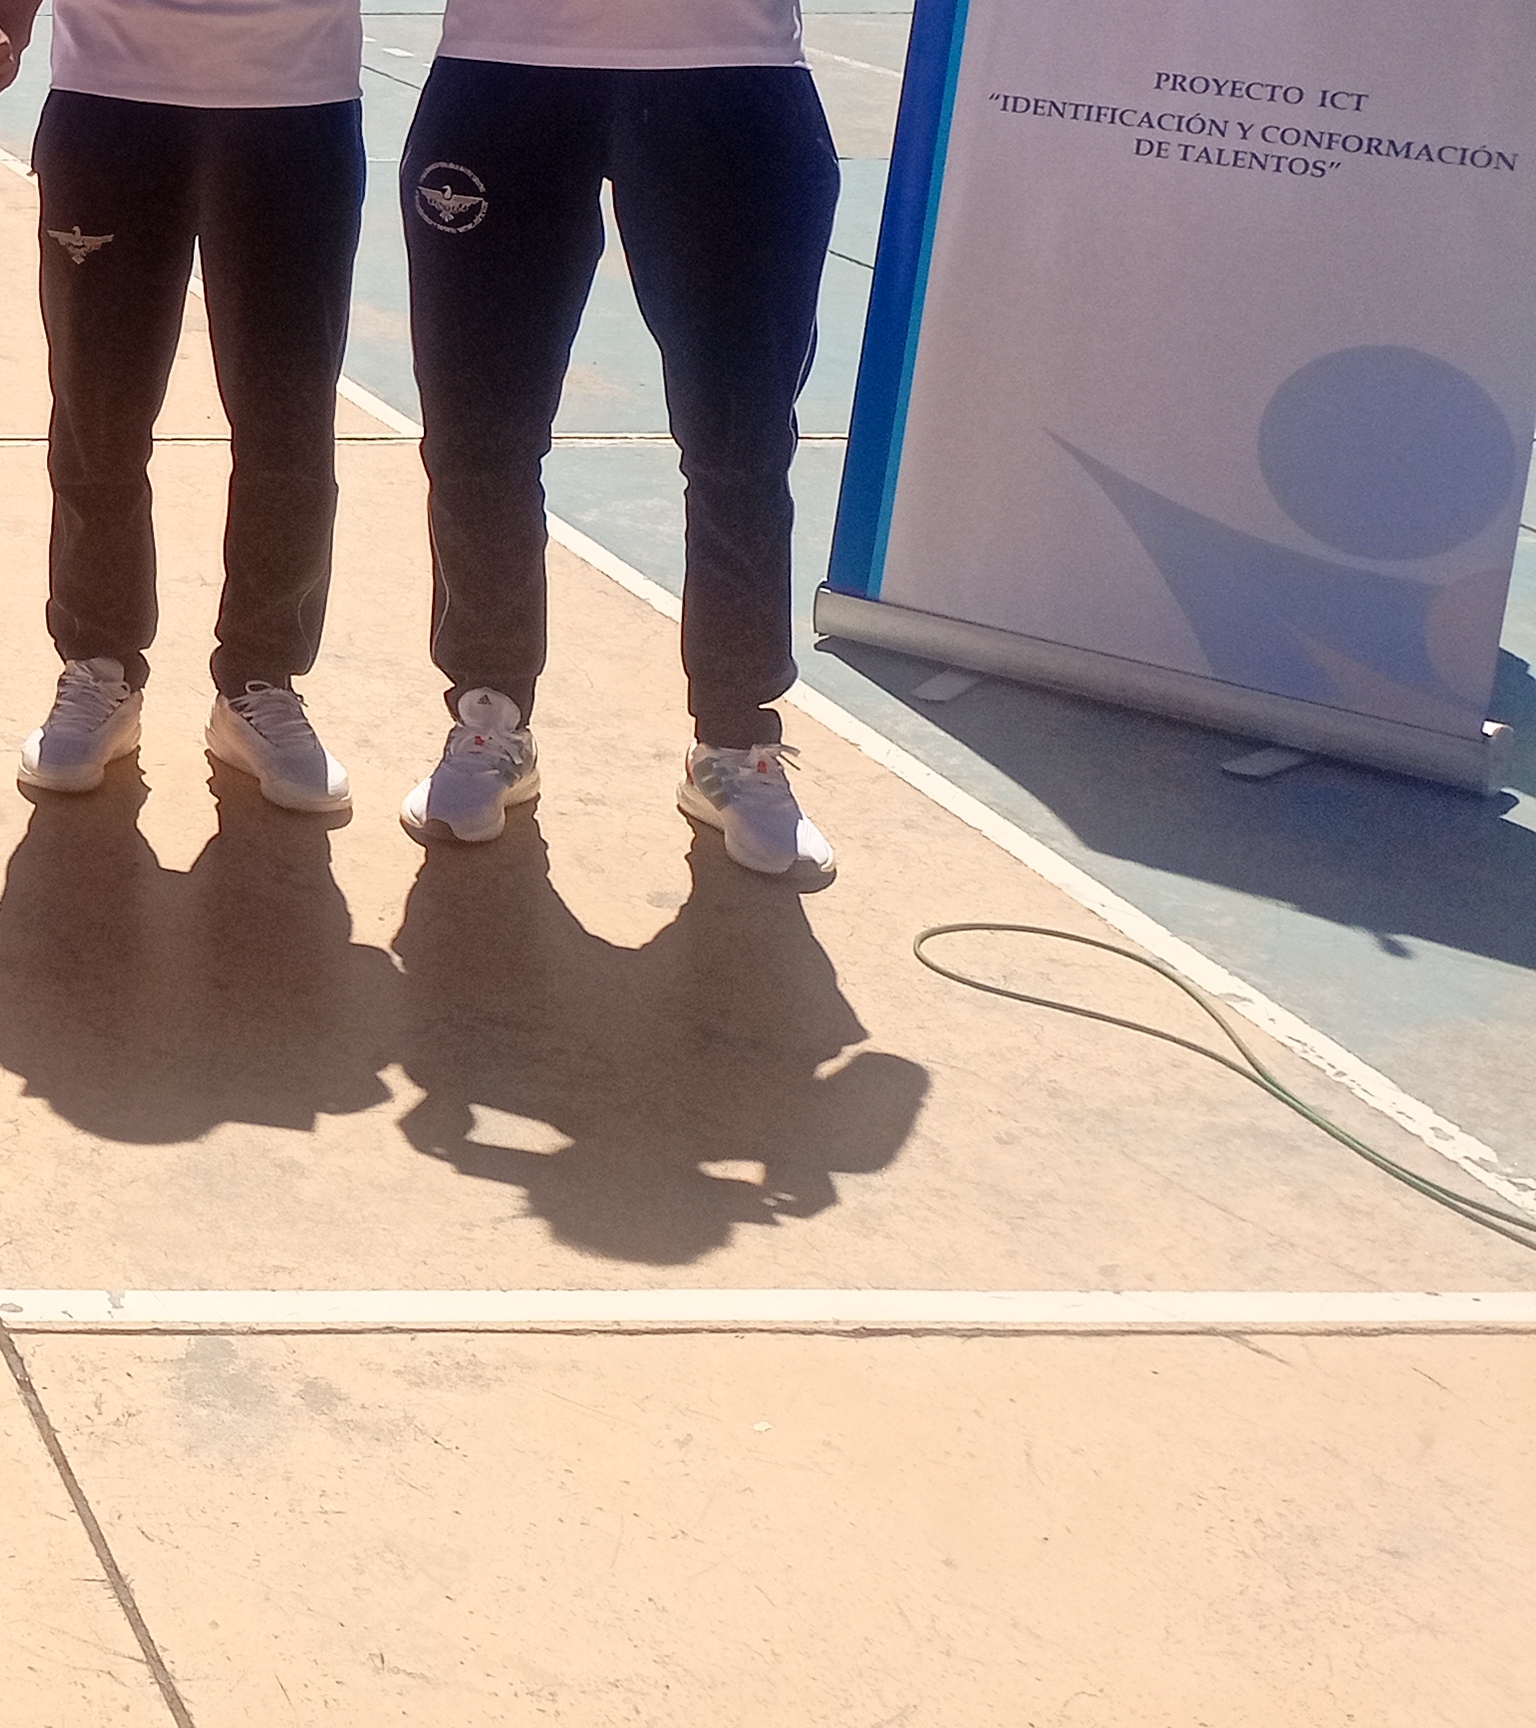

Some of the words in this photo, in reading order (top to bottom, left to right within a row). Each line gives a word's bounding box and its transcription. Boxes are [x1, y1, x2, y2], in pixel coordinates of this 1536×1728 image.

[1153, 72, 1304, 105] PROYECTO
[1317, 90, 1369, 112] ICT
[1134, 138, 1169, 158] DE
[1237, 122, 1256, 140] Y
[1260, 125, 1519, 172] CONFORMACIÓN
